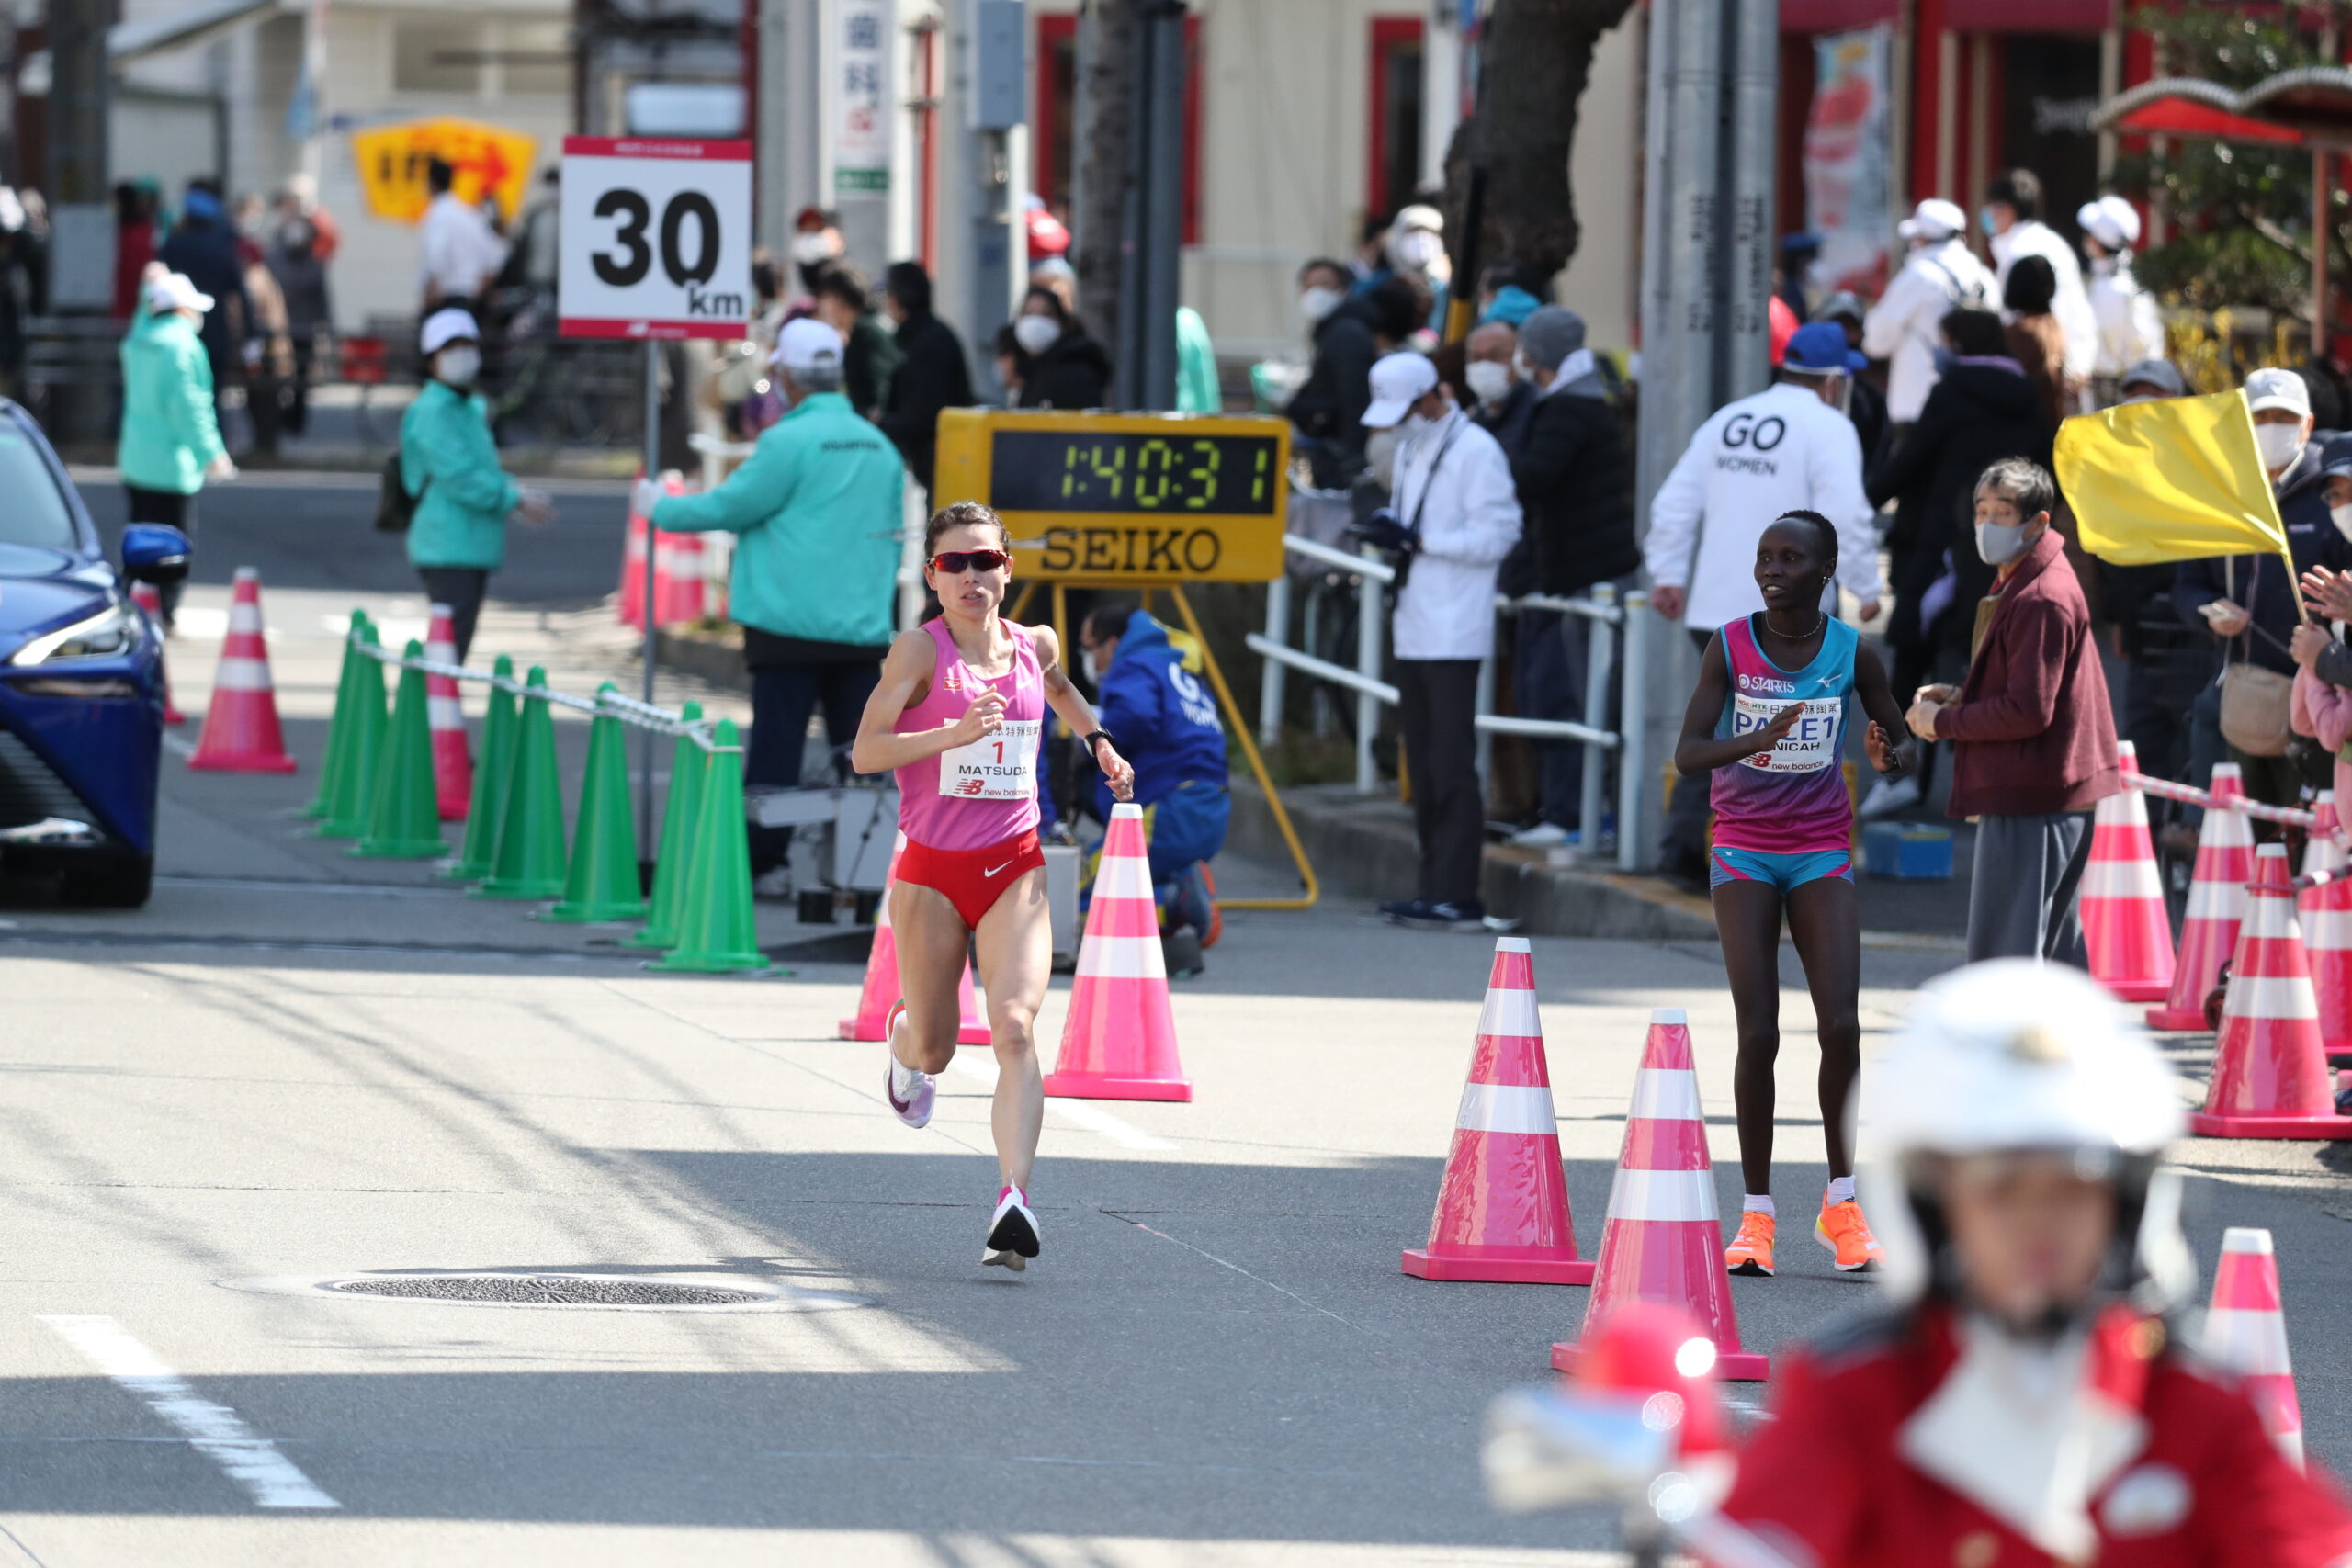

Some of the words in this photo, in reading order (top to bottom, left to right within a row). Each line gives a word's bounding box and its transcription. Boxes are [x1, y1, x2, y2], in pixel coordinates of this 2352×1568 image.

[592, 188, 720, 288] 30
[689, 284, 743, 315] km
[1723, 414, 1786, 451] GO
[1061, 439, 1268, 508] 1:40:31
[1041, 525, 1221, 573] SEIKO
[1736, 712, 1834, 741] PAE1
[992, 741, 1003, 764] 1
[1792, 761, 1824, 771] balance
[958, 765, 1027, 776] MATSUDA
